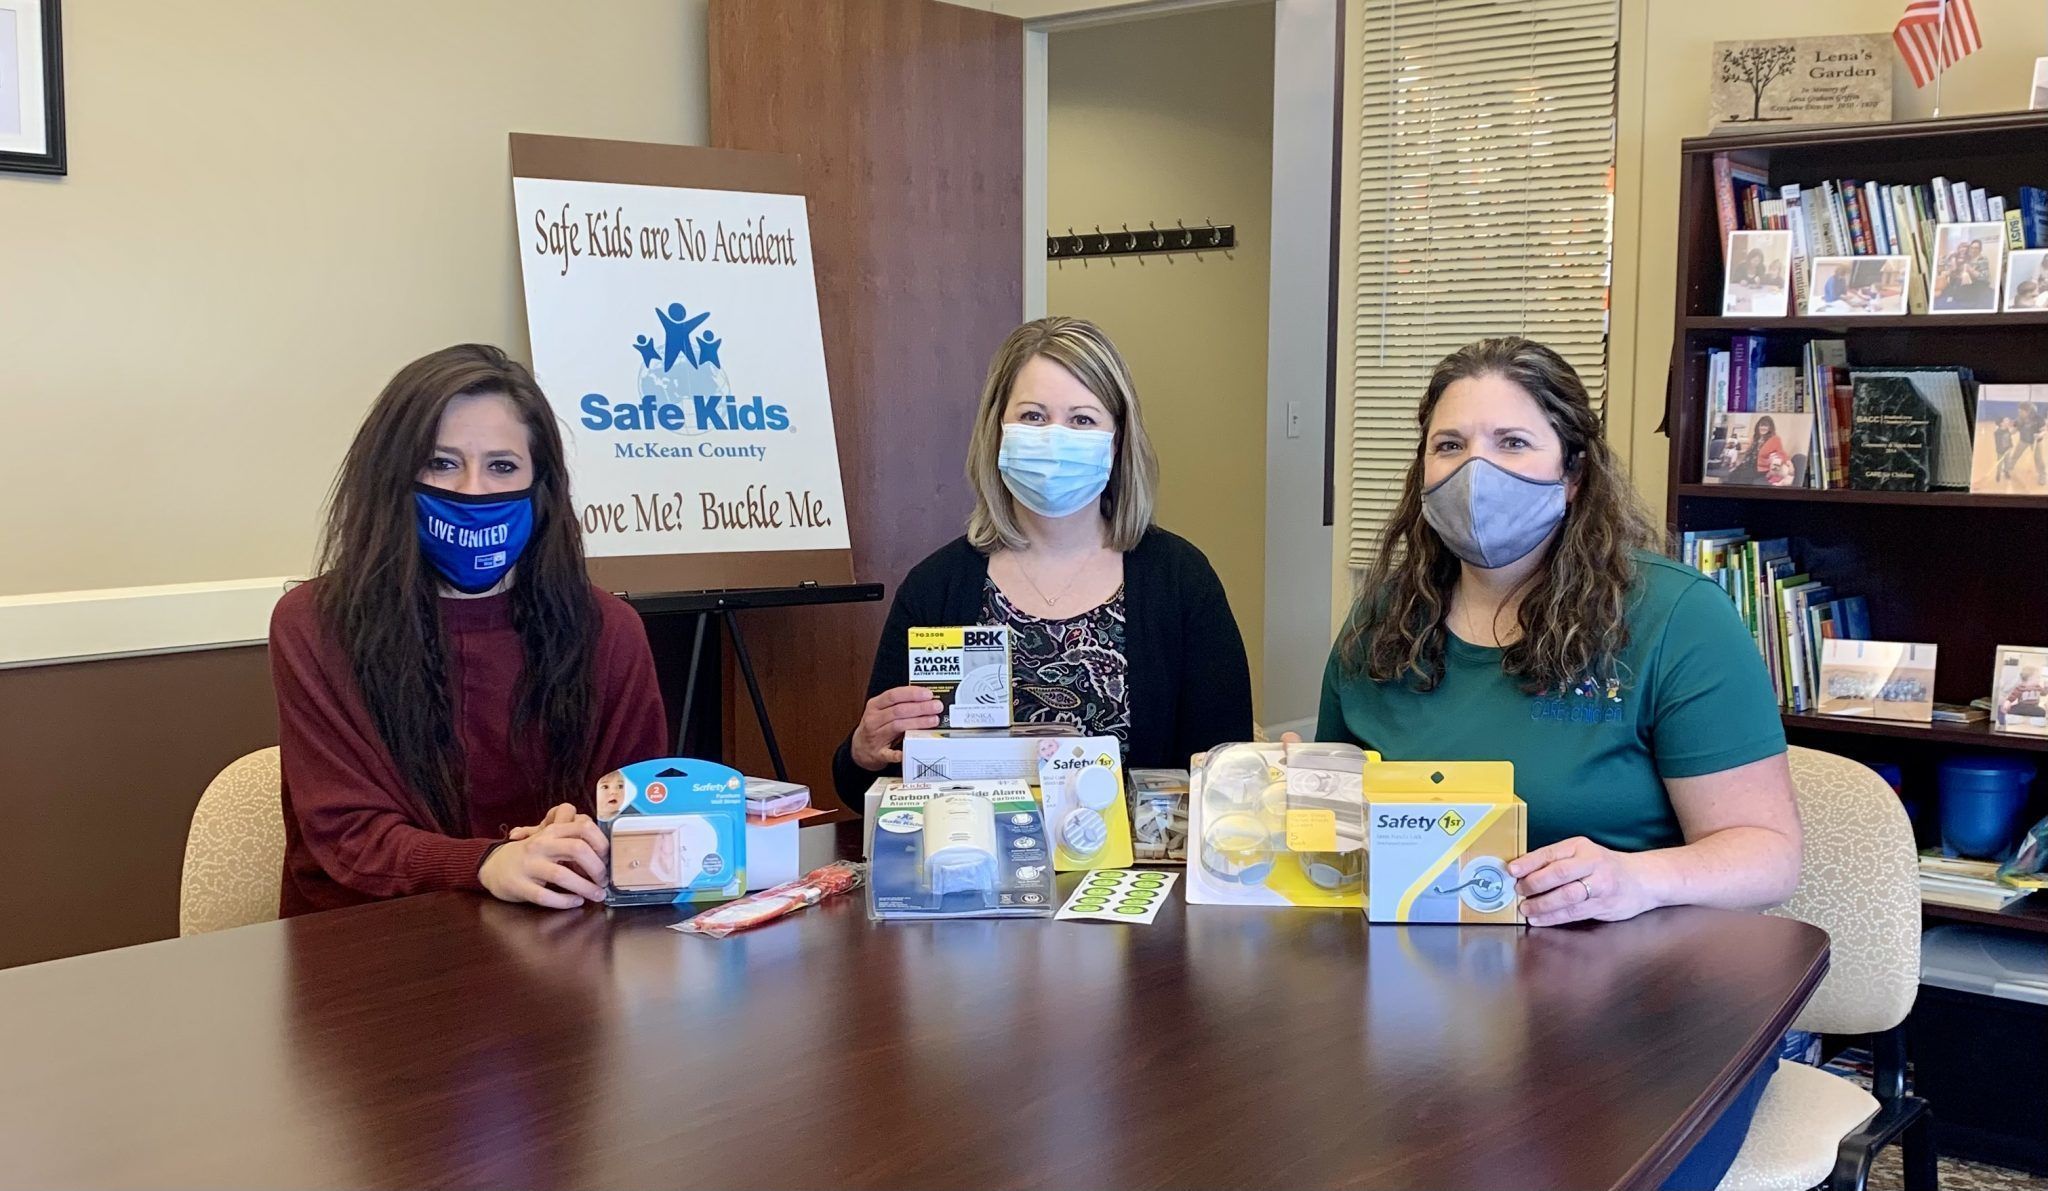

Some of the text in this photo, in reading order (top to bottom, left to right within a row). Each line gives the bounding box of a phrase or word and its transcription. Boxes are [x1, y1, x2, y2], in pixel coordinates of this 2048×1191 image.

[1815, 49, 1873, 63] Lena's
[1808, 66, 1876, 79] Garden
[2009, 220, 2022, 243] BUSY
[535, 203, 797, 277] Safe Kids are No Accident
[1789, 255, 1809, 301] Parenting
[580, 393, 790, 431] Safe Kids
[614, 442, 767, 462] McKean County
[581, 484, 832, 534] ove Me? Buckle Me.
[429, 516, 508, 548] LIVE UNITED
[964, 631, 1003, 646] BRK
[914, 656, 960, 665] SMOKE
[1053, 759, 1094, 770] Safety
[653, 786, 659, 794] 2
[692, 783, 727, 792] Safety
[992, 789, 1026, 797] Alarm
[1377, 815, 1437, 831] Safety
